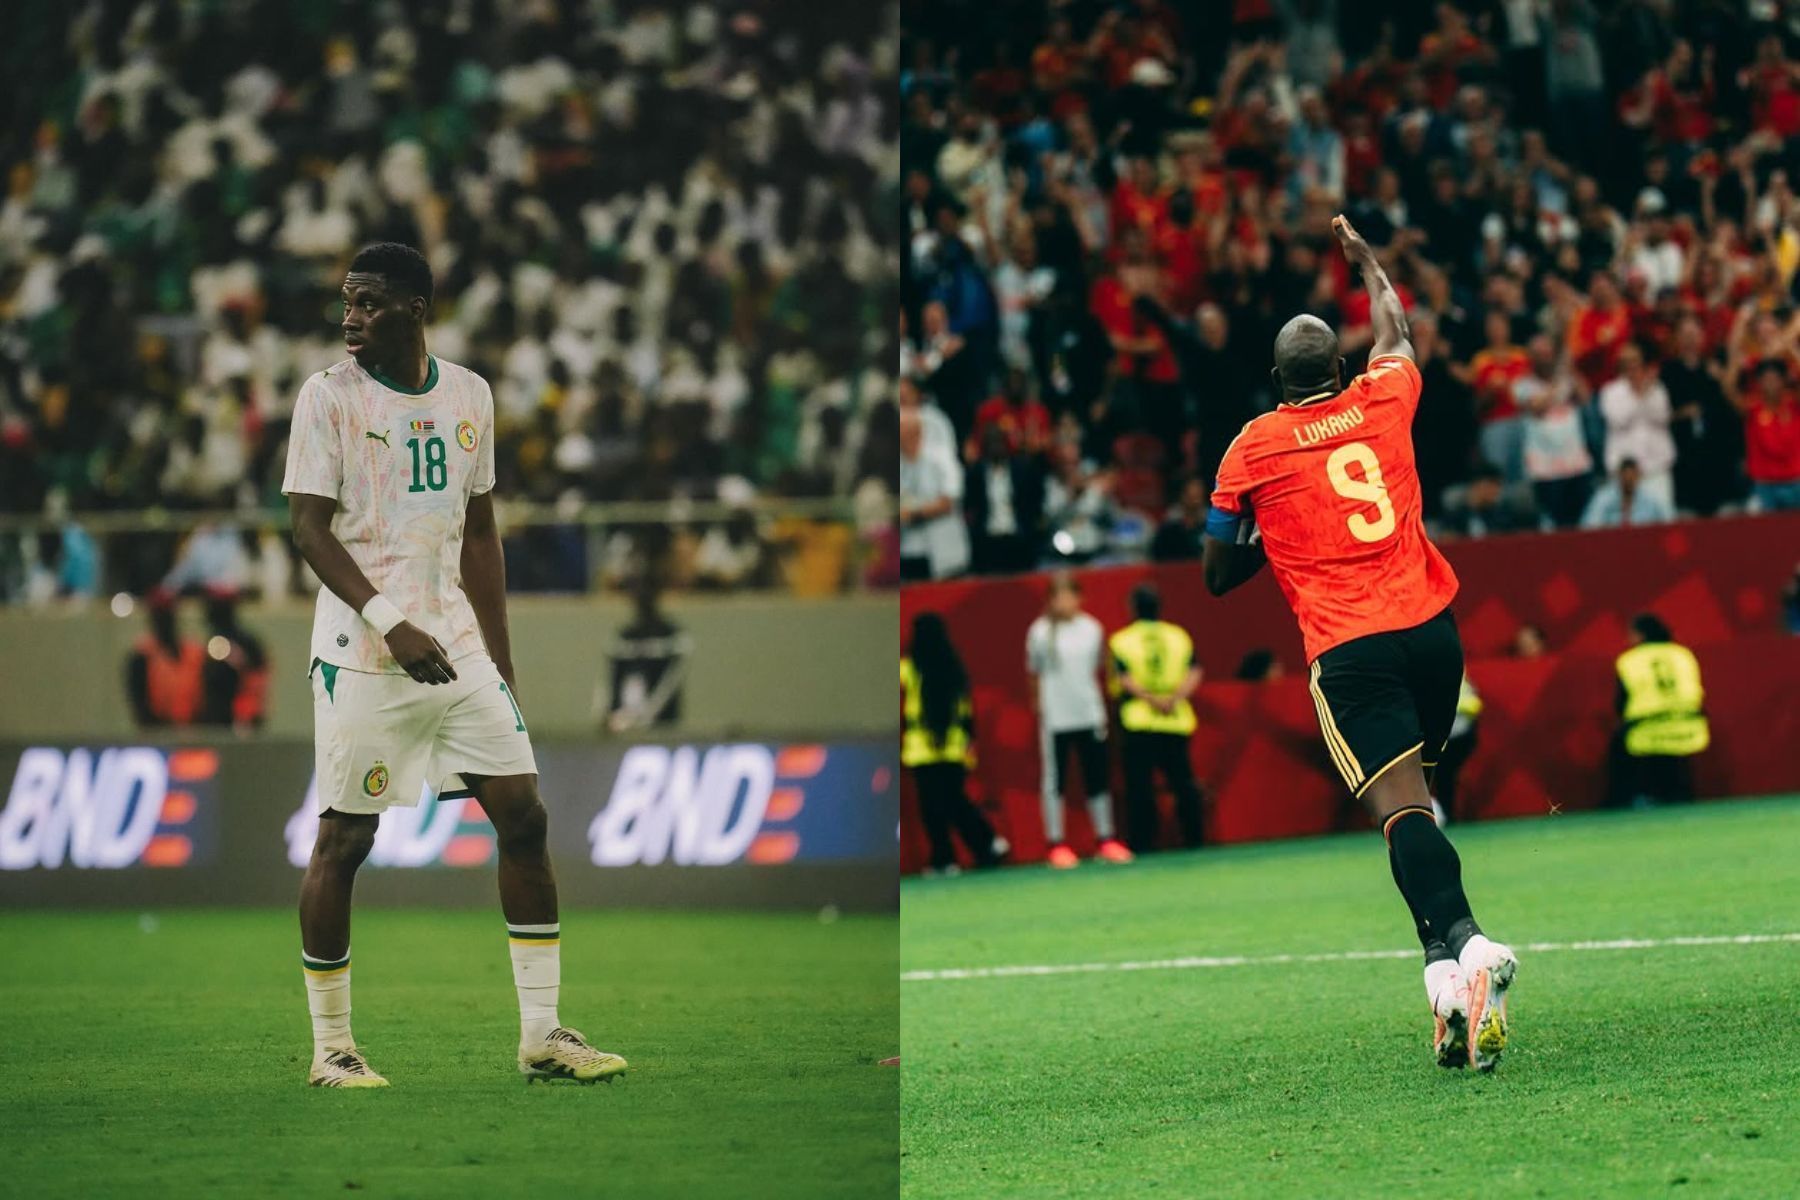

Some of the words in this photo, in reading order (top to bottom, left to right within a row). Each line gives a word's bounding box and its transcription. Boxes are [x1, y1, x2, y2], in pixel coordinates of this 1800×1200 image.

[1293, 405, 1365, 447] LUKAKU
[406, 437, 448, 493] 18
[1326, 442, 1396, 543] 9
